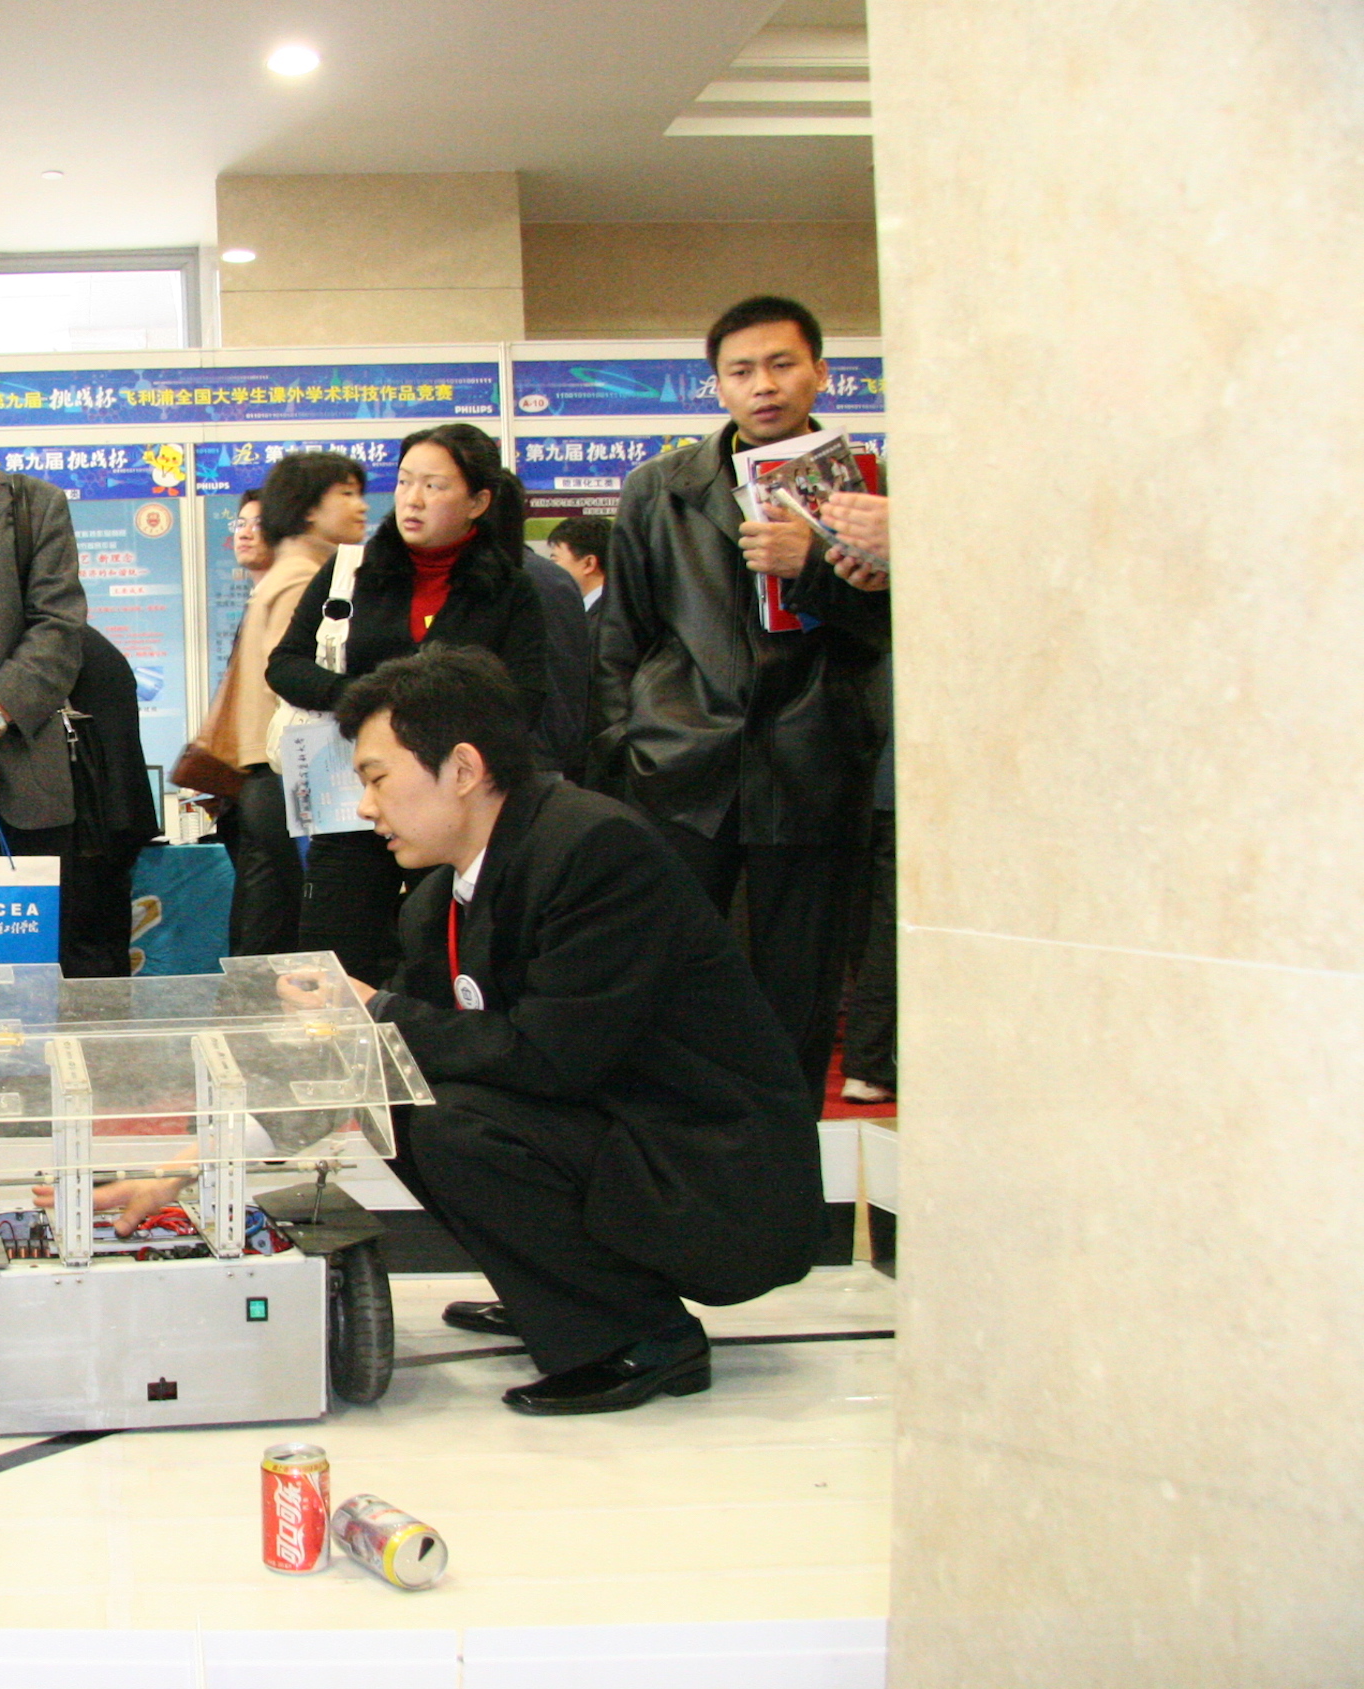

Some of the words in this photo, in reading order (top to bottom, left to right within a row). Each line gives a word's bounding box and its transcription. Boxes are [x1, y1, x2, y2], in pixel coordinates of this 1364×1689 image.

[522, 399, 545, 408] A-10
[454, 405, 493, 414] PHILIPS
[196, 481, 231, 490] PHILIPS
[273, 1474, 306, 1566] 可口可乐
